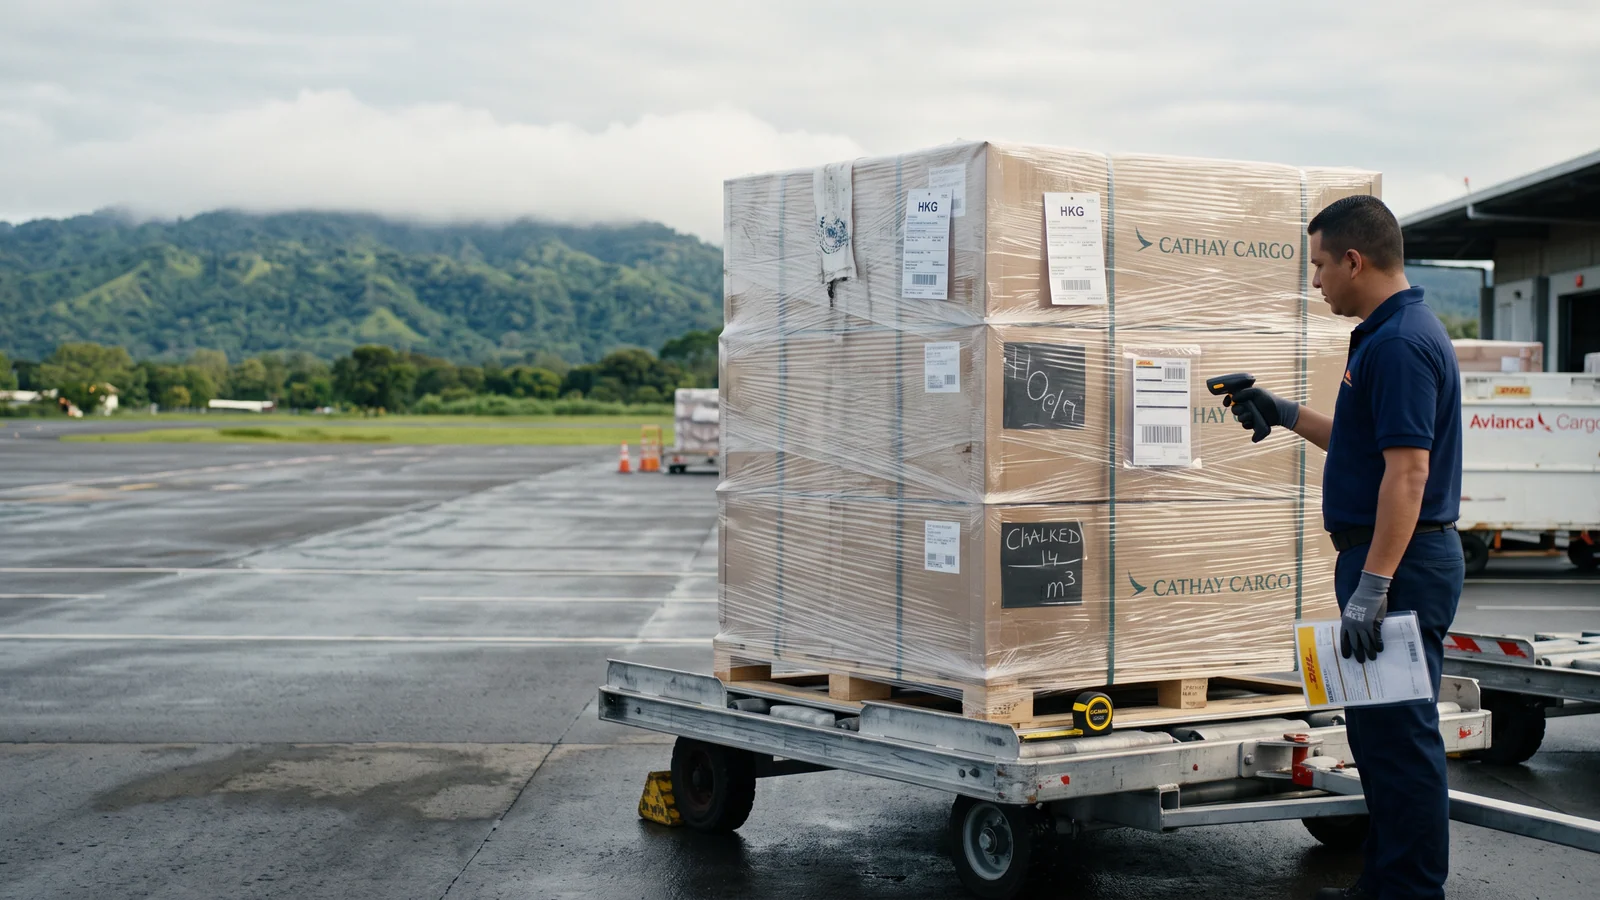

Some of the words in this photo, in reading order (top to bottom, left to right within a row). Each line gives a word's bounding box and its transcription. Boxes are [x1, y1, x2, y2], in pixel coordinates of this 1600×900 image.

[917, 201, 938, 212] HKG
[1060, 206, 1084, 217] HKG
[1159, 236, 1229, 256] CATHAY
[1233, 240, 1295, 259] CARGO
[1193, 406, 1227, 423] HAY
[1469, 413, 1535, 429] Avianca
[1153, 577, 1224, 597] CATHAY
[1229, 573, 1291, 592] CARGO
